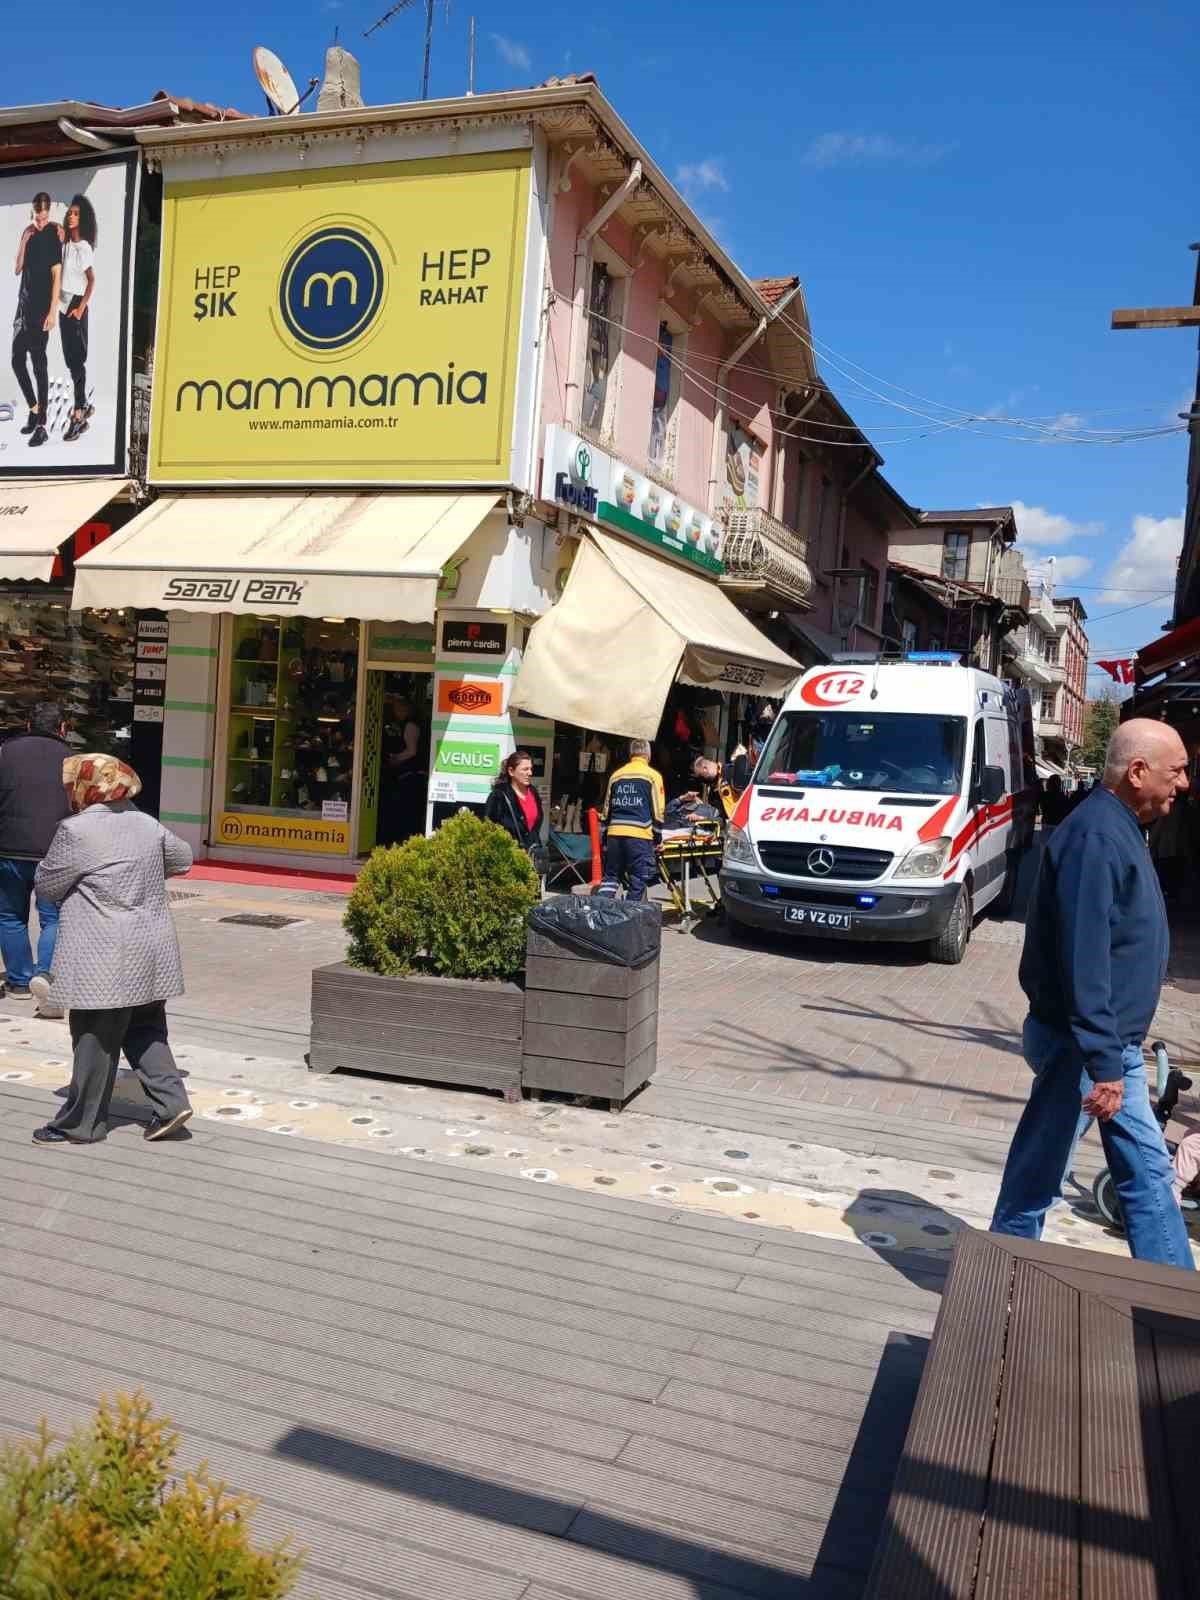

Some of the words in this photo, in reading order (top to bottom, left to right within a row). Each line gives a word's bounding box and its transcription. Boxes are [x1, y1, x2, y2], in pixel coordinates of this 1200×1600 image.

[421, 248, 491, 282] HEP
[194, 265, 241, 290] HEP
[303, 271, 358, 308] m
[419, 285, 489, 306] RAHAT
[193, 291, 238, 322] ŞIK
[176, 361, 488, 412] mammamia
[248, 416, 399, 431] www.mammamia.com.tr
[162, 578, 241, 603] Saray
[243, 579, 304, 605] Park
[447, 638, 472, 649] pierre
[473, 640, 500, 649] cardin
[822, 679, 865, 695] 112
[439, 750, 494, 768] VENÜS
[245, 823, 345, 844] mammamia
[810, 910, 826, 923] VZ
[828, 913, 849, 927] 071
